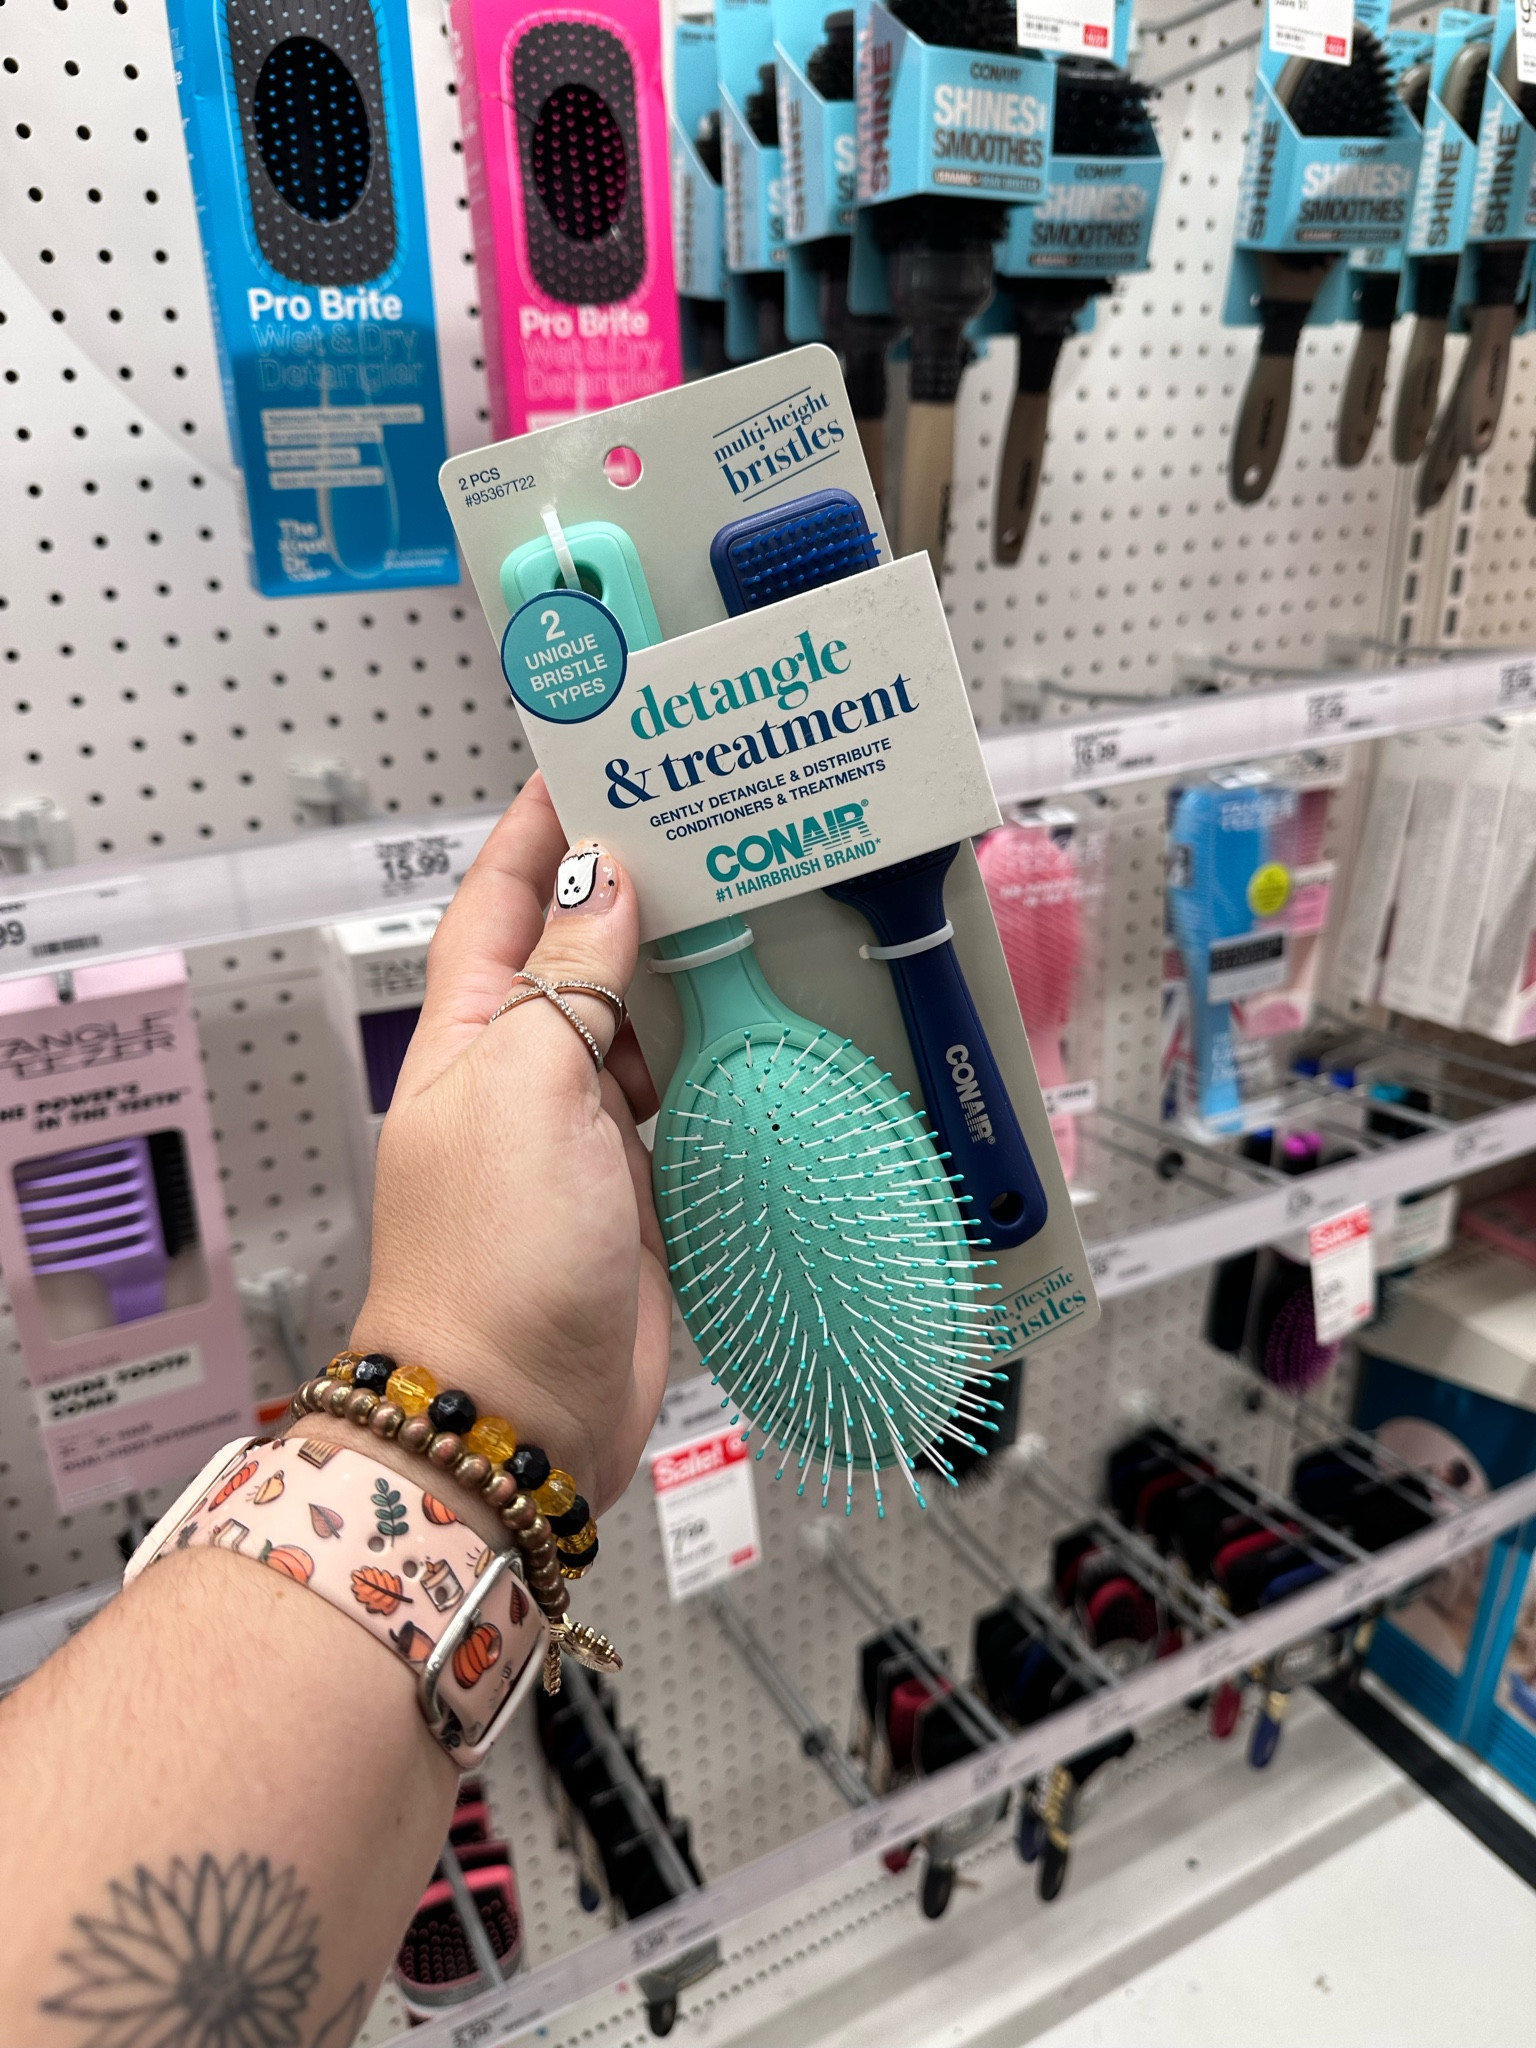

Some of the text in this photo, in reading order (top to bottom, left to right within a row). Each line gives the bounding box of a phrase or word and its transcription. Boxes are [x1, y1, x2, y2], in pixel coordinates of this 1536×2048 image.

[866, 40, 893, 193] SHINE
[933, 128, 1044, 168] SMOOTHES
[1427, 140, 1463, 247] SHINE
[1484, 120, 1522, 234] SHINE
[1030, 221, 1140, 248] SMOOTHES
[247, 285, 403, 321] Pro Brite
[518, 304, 650, 340] Pro Brite
[251, 322, 418, 364] Wet & Dry
[712, 392, 831, 464] multi-height
[718, 418, 845, 497] bristles
[458, 467, 501, 491] 2 PCS
[464, 475, 537, 507] #95367T22
[540, 609, 566, 642] 2
[524, 632, 598, 671] UNIQUE
[529, 653, 608, 693] BRISTLE
[545, 677, 606, 709] TYPES
[629, 629, 852, 741] detangle
[605, 672, 920, 810] & treatment
[649, 737, 893, 828] GENTLY DETANGLE & DISTRIBUTE
[665, 758, 887, 842] CONDITIONERS & TREATMENTS
[382, 850, 450, 881] 15.99
[715, 888, 734, 903] #1
[735, 859, 822, 896] HAIRBRUSH
[1014, 1270, 1075, 1312] flexible
[985, 1289, 1087, 1355] bristles
